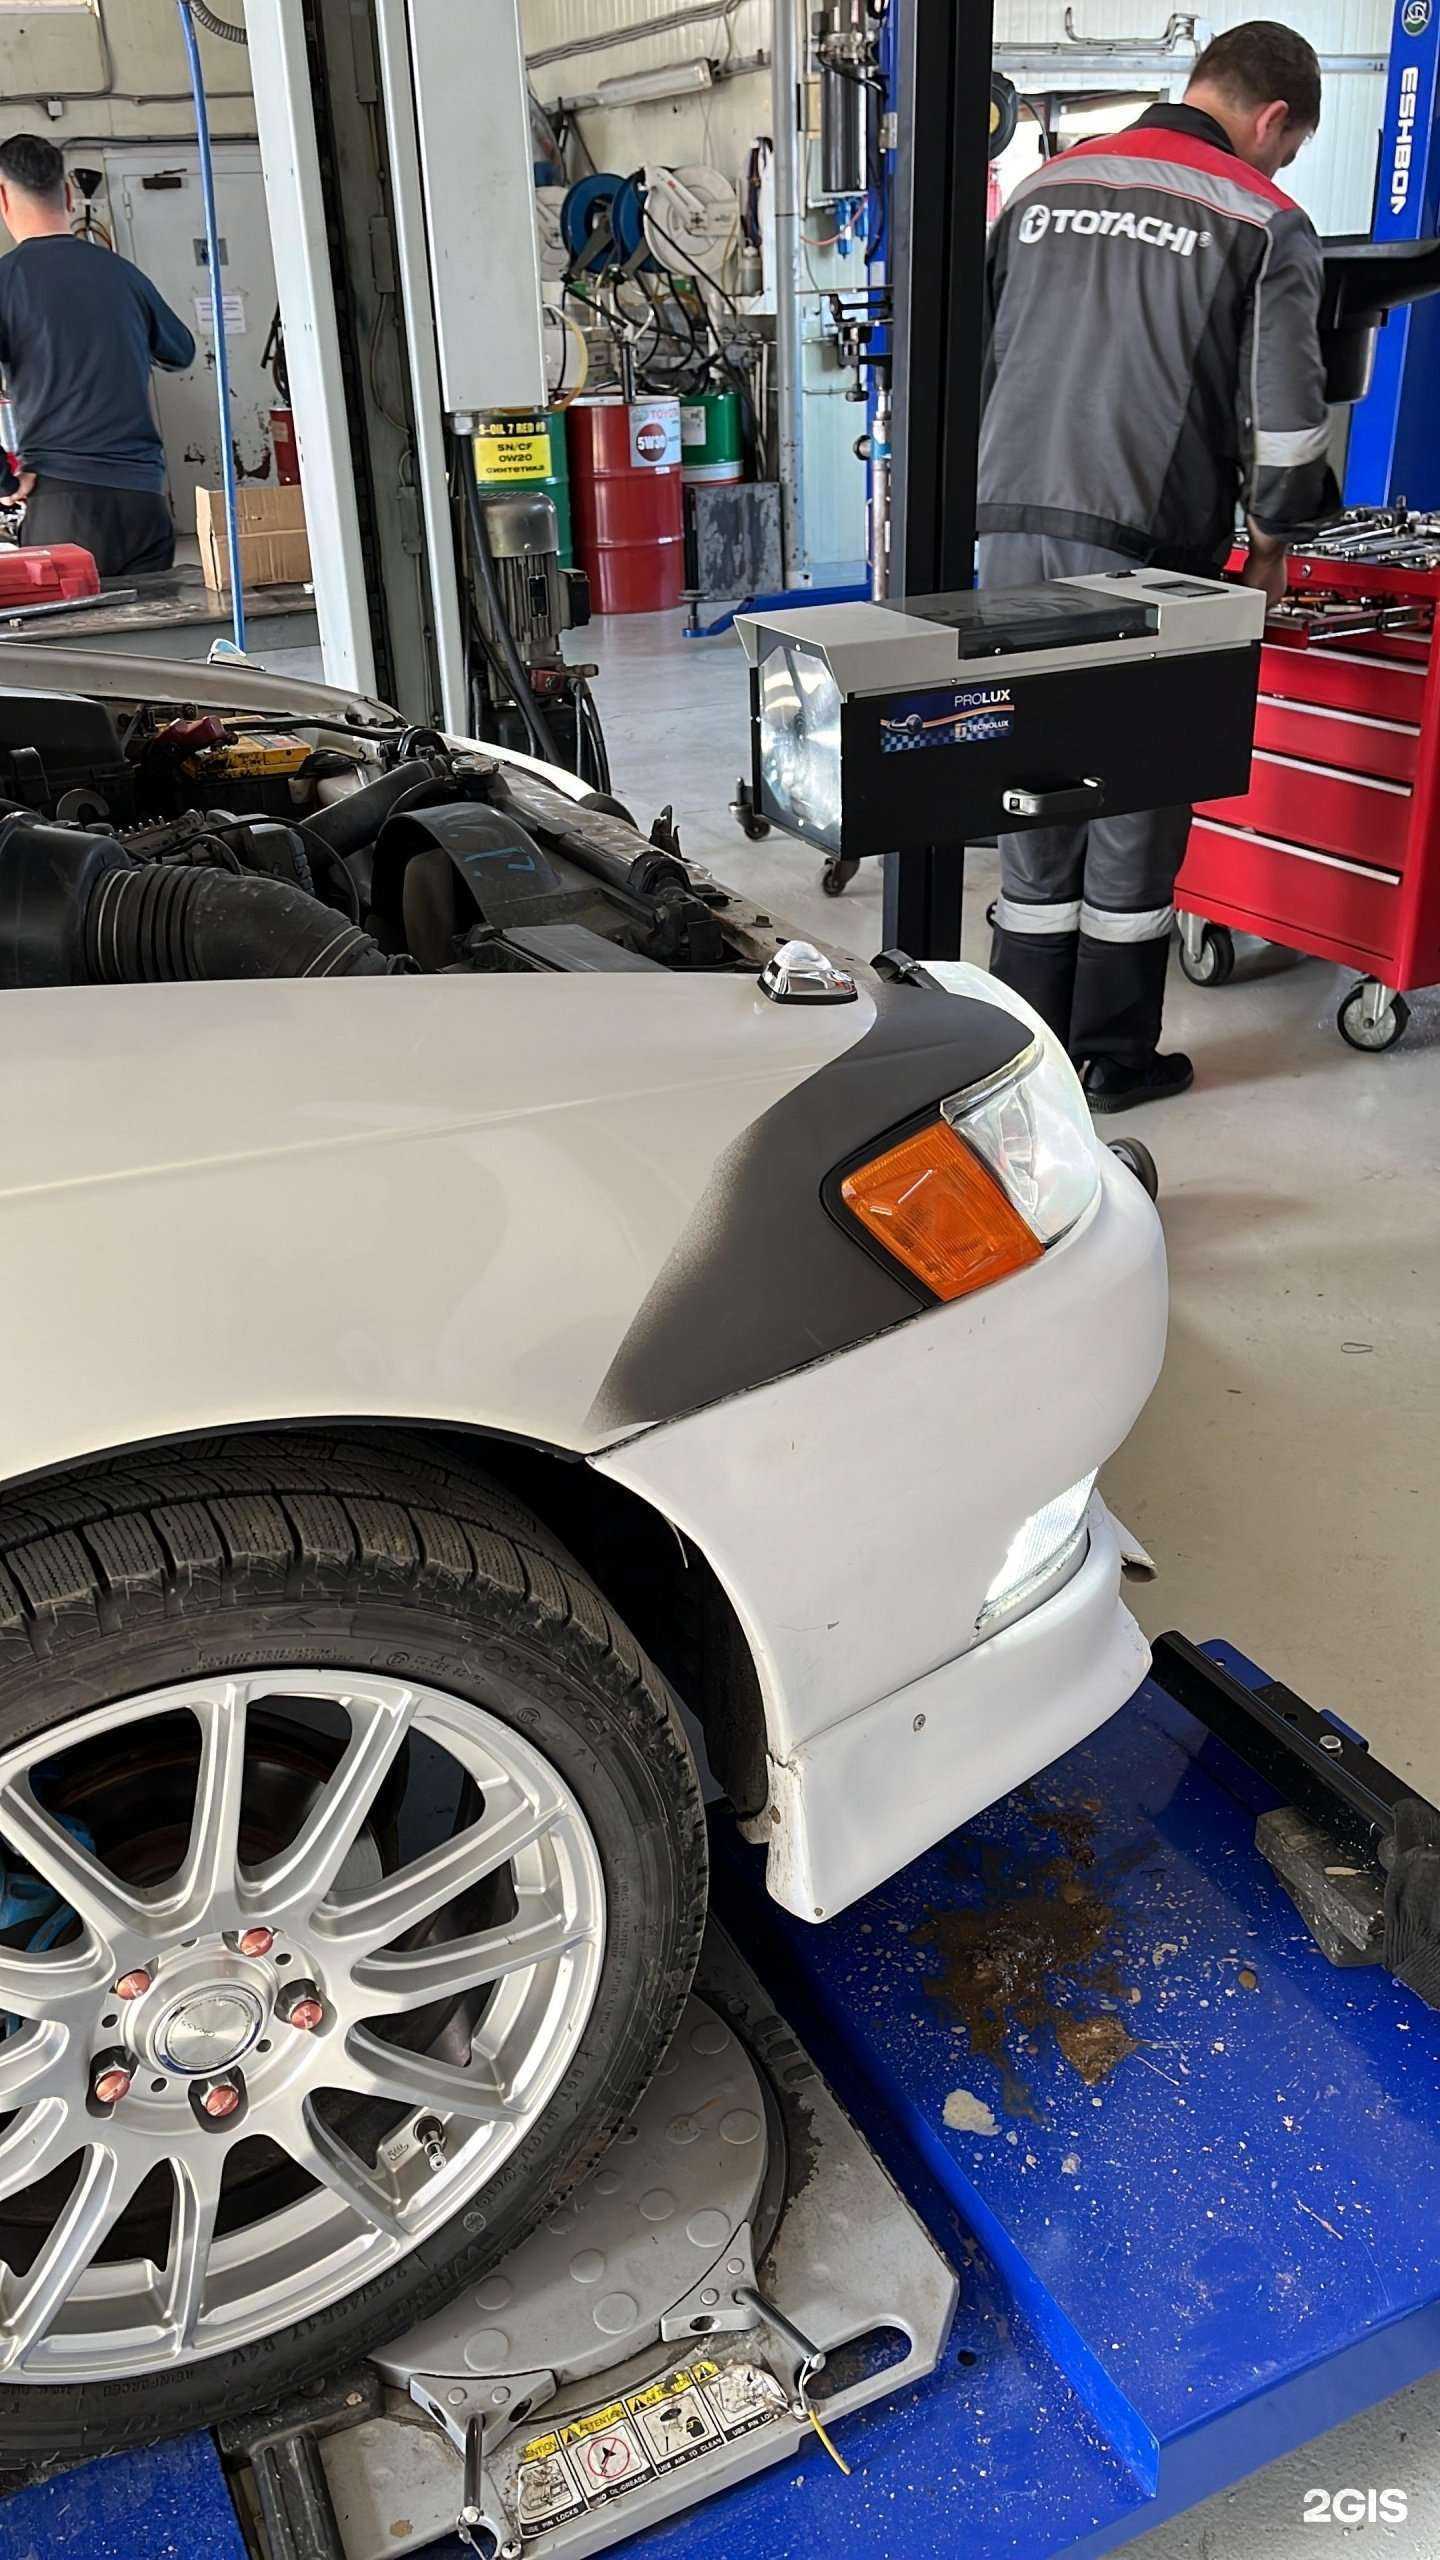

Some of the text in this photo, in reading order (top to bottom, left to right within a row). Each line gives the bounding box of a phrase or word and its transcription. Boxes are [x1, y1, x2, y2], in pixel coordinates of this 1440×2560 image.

[955, 689, 1011, 707] PROLUX
[658, 2462, 671, 2472] USE
[689, 2450, 698, 2458] TO
[700, 2438, 723, 2452] CLEAN
